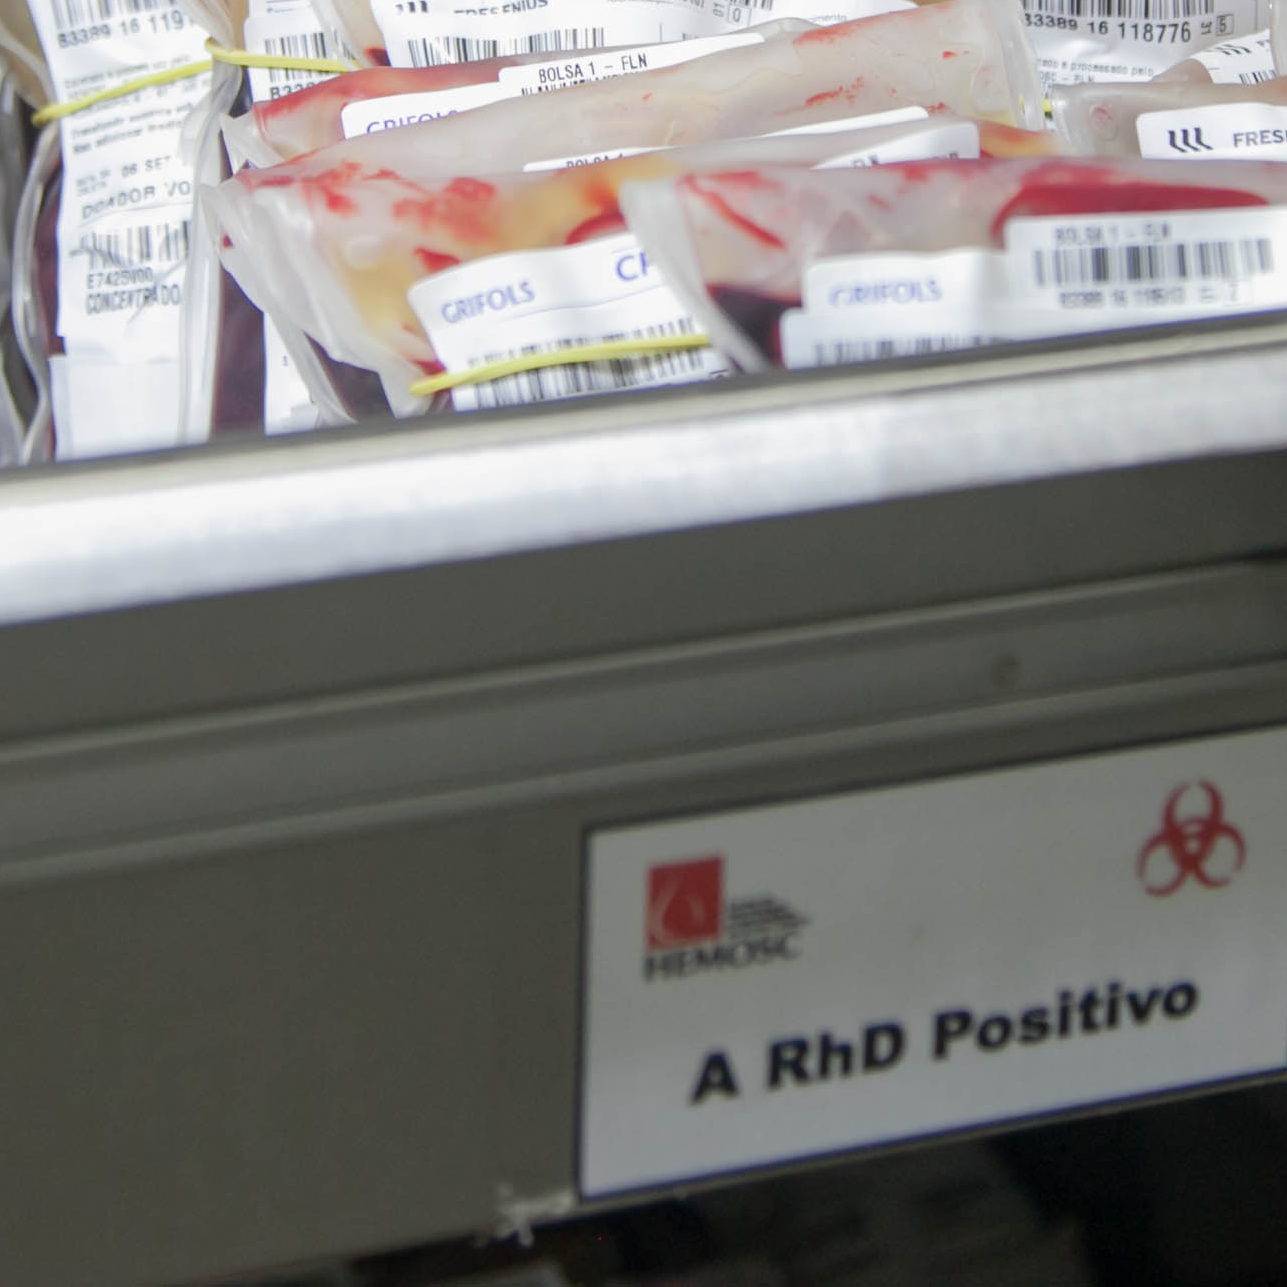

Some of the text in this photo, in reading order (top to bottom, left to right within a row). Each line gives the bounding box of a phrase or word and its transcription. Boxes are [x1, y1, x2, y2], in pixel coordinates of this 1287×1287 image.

[121, 18, 140, 34] 16
[149, 10, 185, 33] 119
[1087, 21, 1109, 35] 16
[1118, 22, 1191, 43] 118776
[538, 53, 649, 83] BOLSA 1 FLN
[441, 279, 535, 324] GRIFOLS
[643, 936, 804, 982] HEMOSC
[689, 979, 1199, 1106] A RhD Positivo
